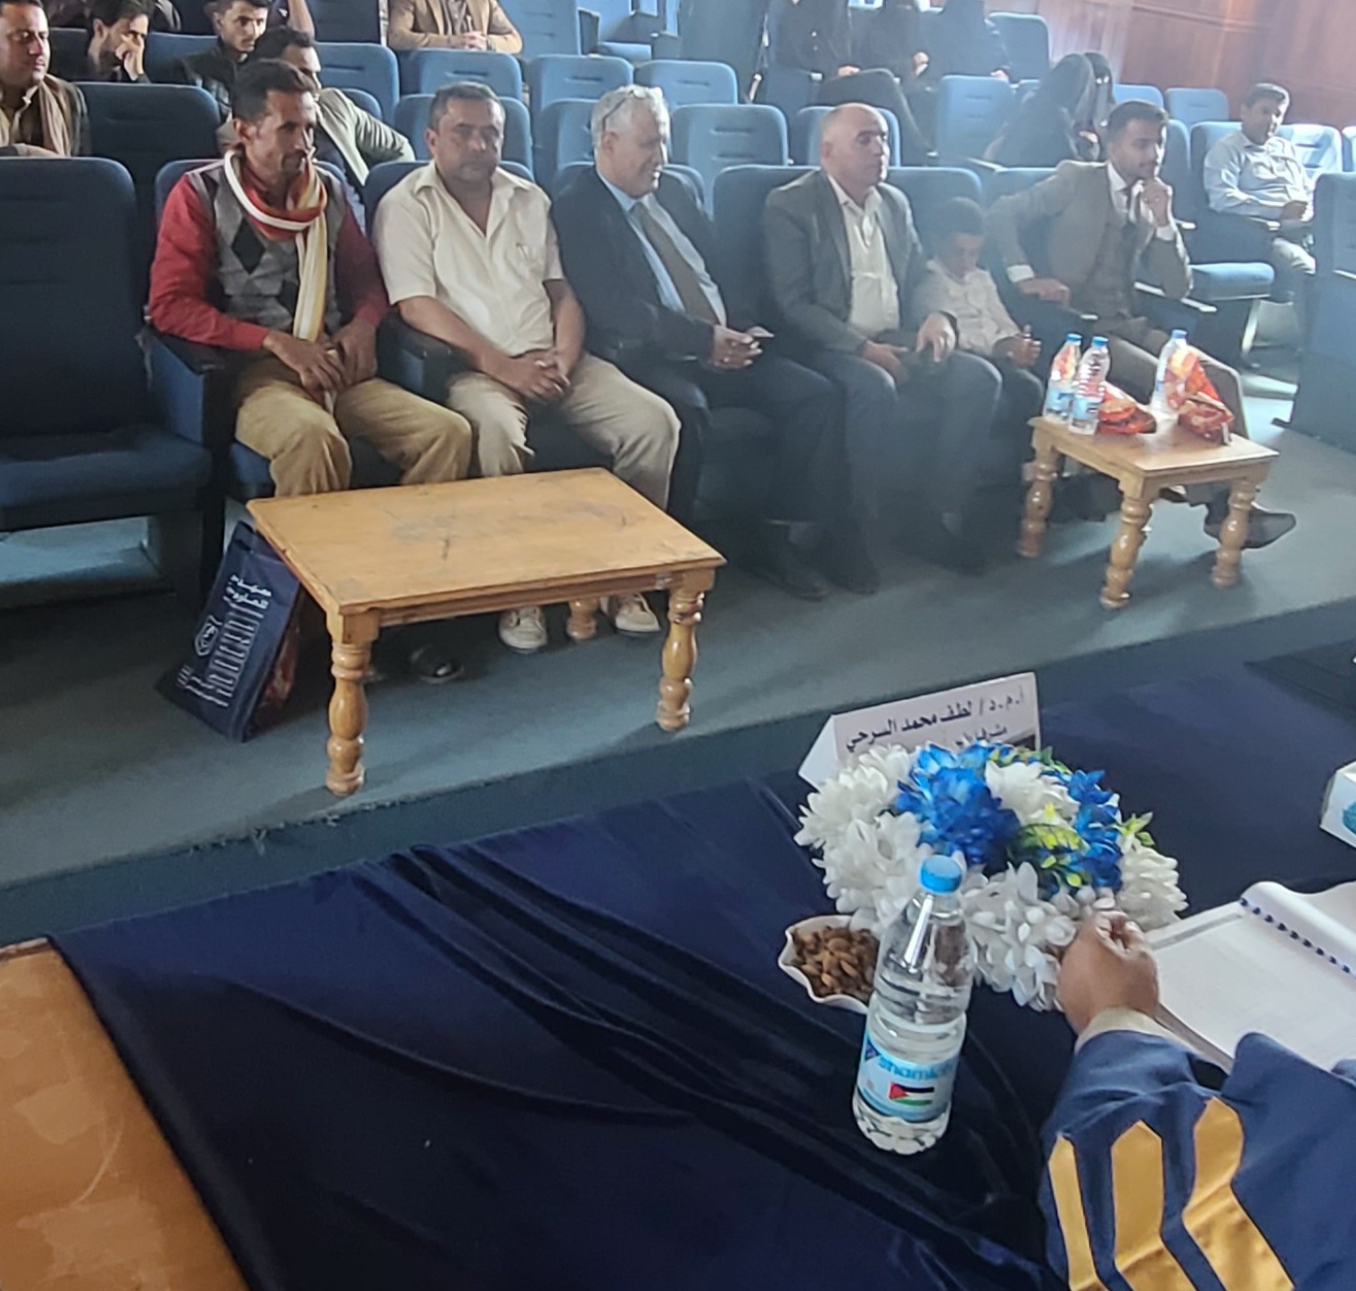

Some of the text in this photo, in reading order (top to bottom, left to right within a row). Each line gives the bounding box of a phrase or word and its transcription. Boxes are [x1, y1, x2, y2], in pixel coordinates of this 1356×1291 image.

[846, 702, 972, 753] لطف محمد السرحي
